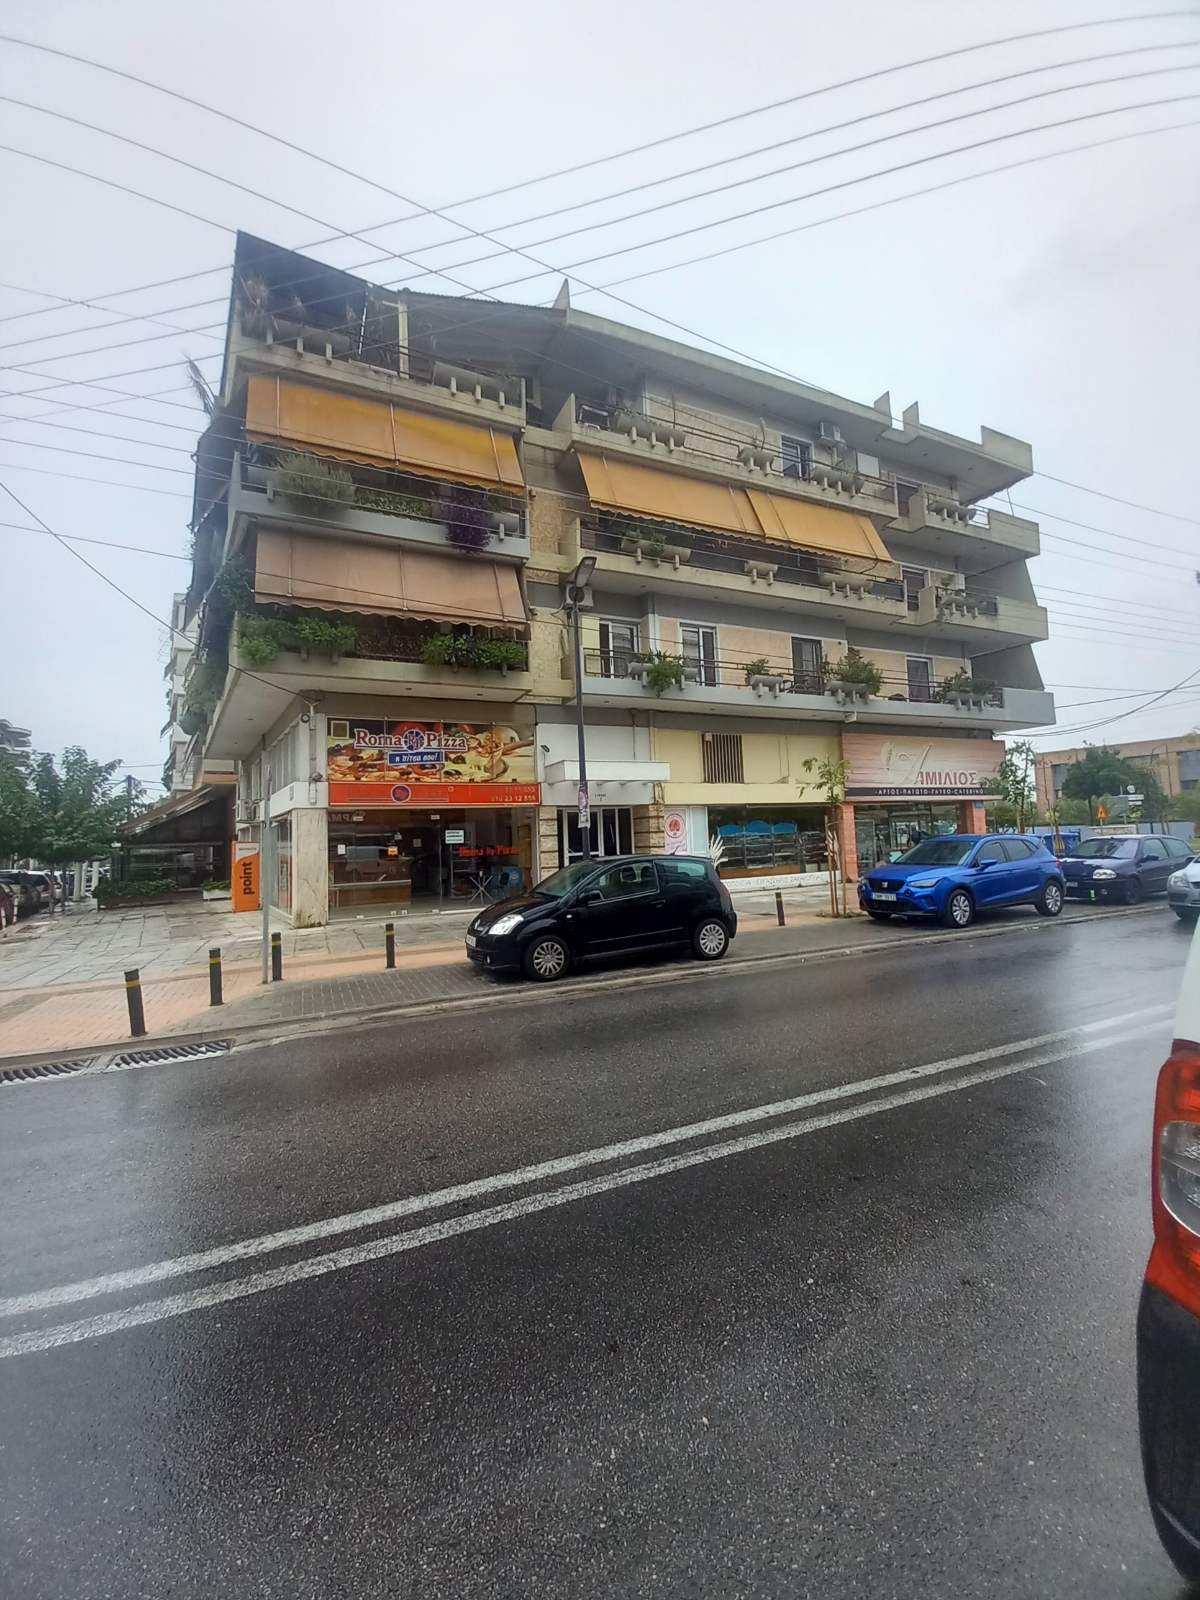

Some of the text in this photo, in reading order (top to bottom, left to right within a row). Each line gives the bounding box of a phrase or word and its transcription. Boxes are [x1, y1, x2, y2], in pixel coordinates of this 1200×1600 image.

[355, 729, 466, 748] Roma Pizza
[240, 862, 255, 895] point
